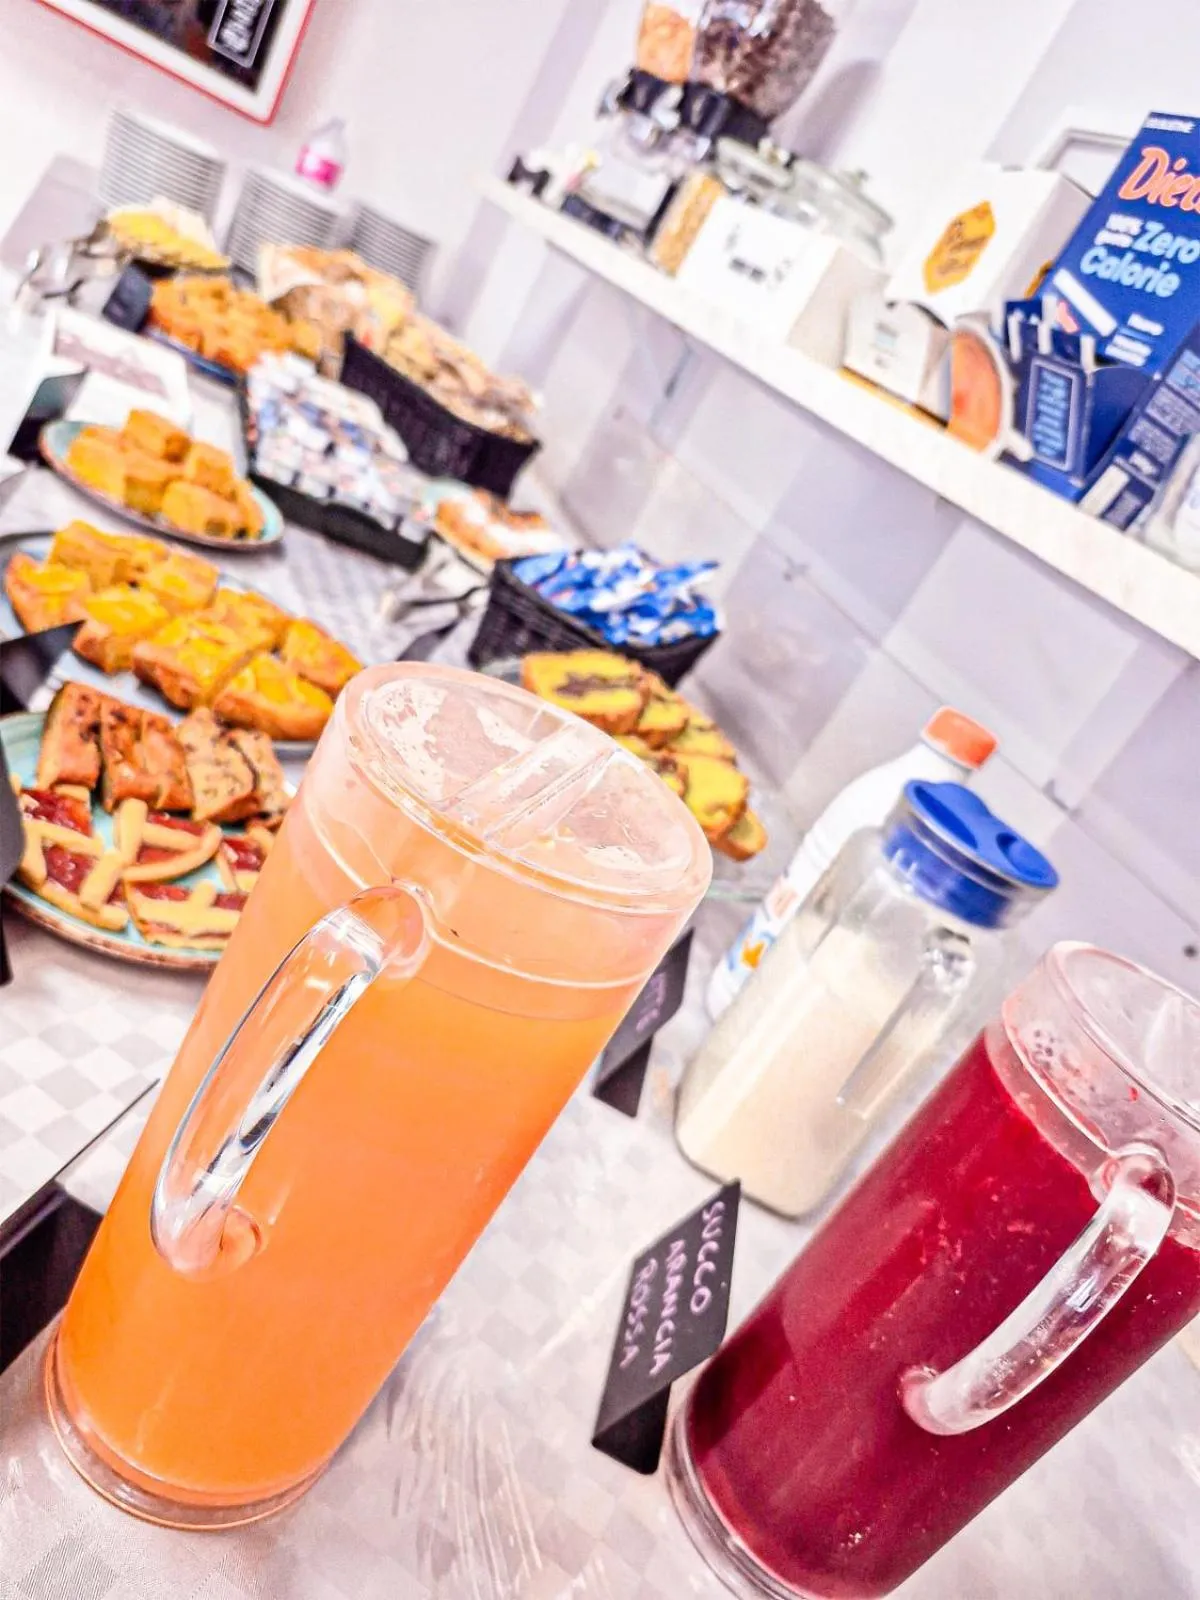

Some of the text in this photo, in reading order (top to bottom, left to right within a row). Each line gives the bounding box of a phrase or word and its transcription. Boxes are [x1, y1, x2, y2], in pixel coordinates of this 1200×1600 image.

[1080, 246, 1180, 298] Calorie
[1132, 220, 1200, 264] Zero
[619, 1258, 658, 1370] ROSSA
[650, 1239, 687, 1376] ARANCIA
[690, 1201, 726, 1315] SUCCO
